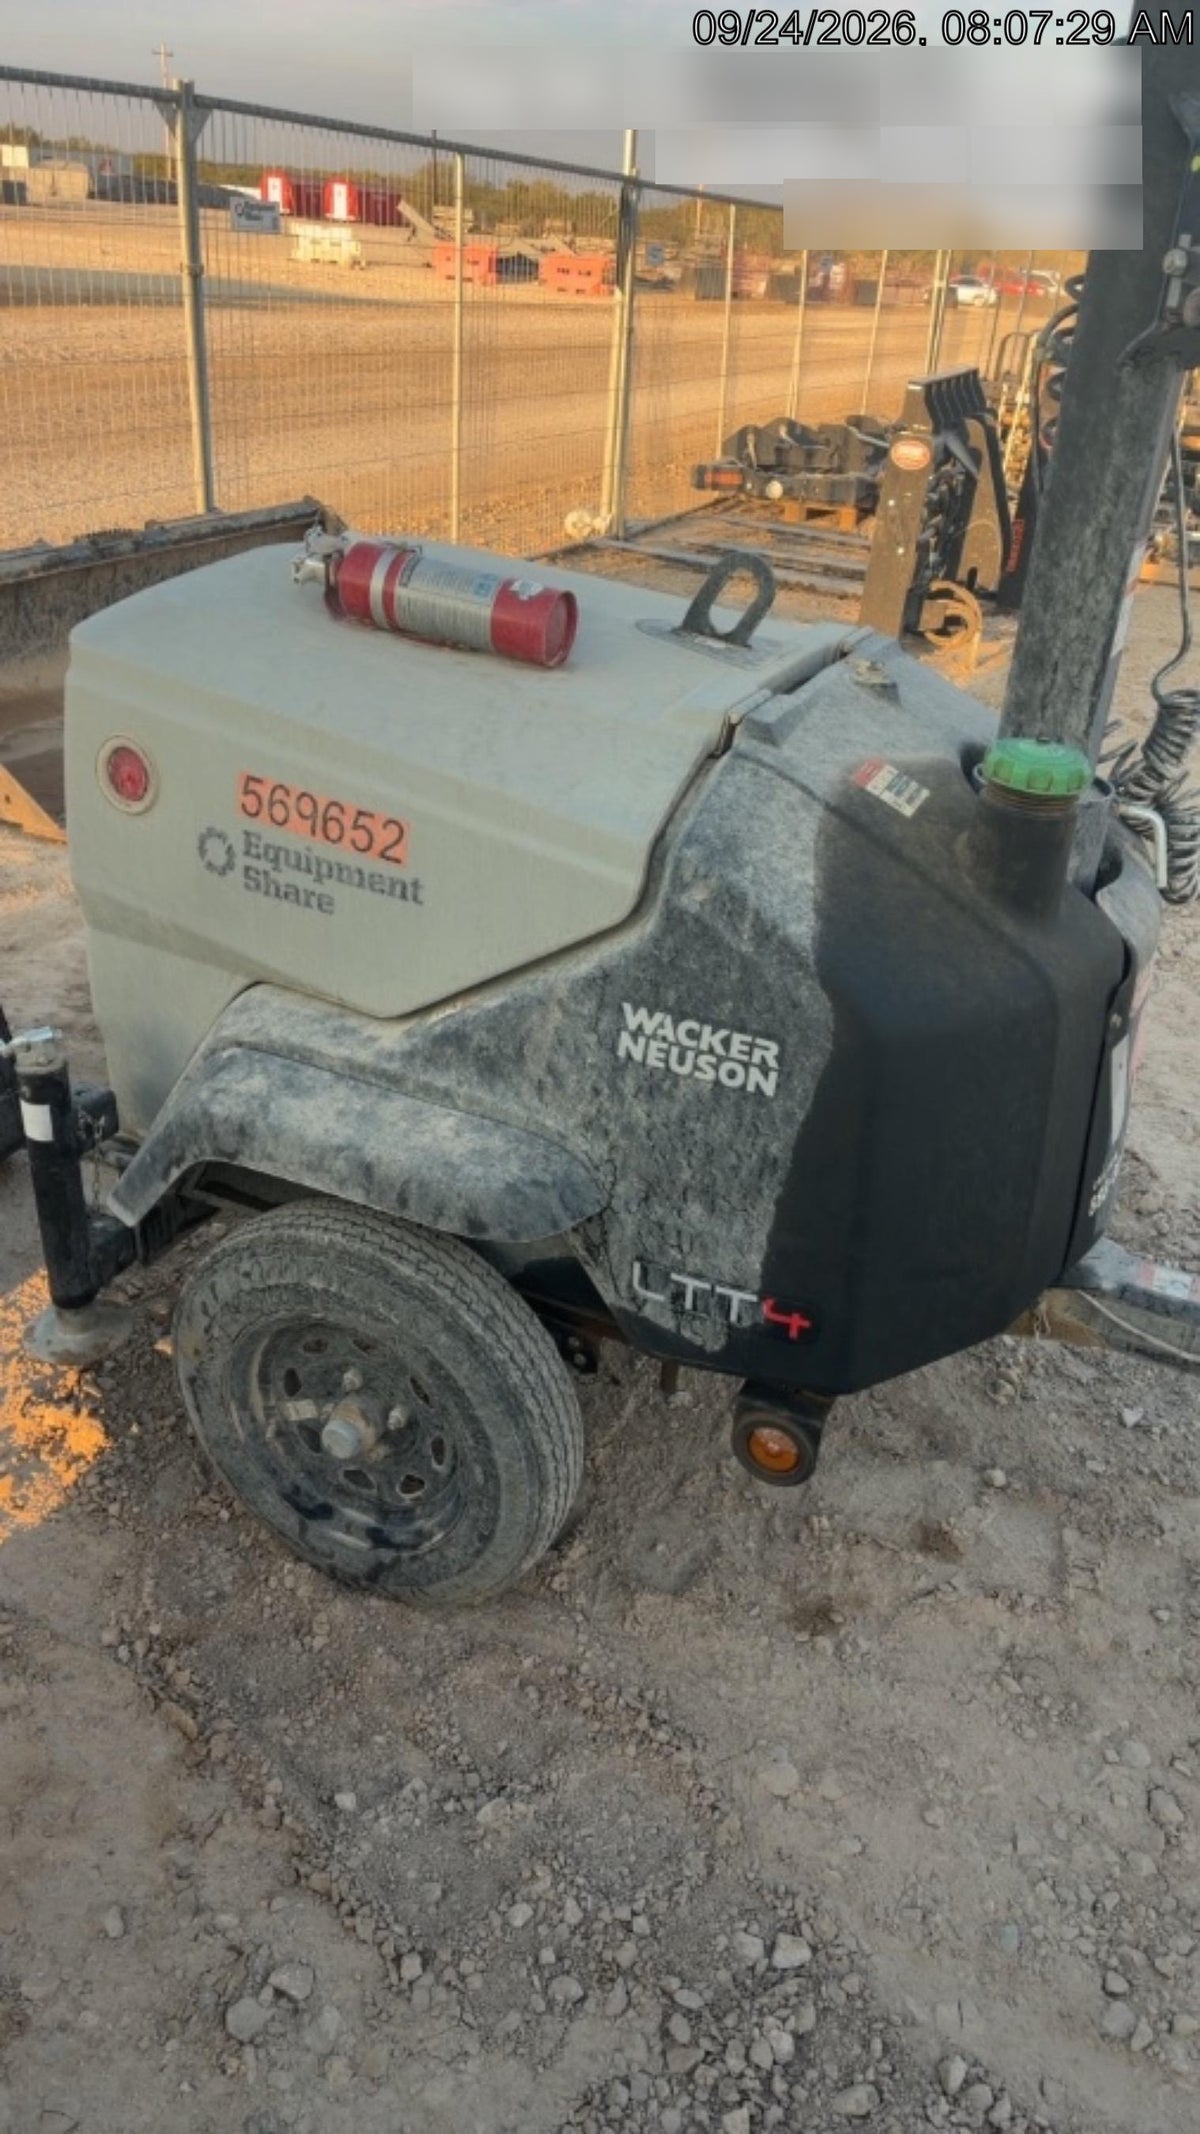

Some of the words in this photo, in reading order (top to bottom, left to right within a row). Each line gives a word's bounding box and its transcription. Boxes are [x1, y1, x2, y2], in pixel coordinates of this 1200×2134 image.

[240, 774, 407, 864] 569652
[242, 829, 425, 906] Equipment
[243, 865, 336, 916] Share
[617, 1031, 779, 1098] NEUSON
[621, 1002, 780, 1070] WACKER
[632, 1260, 812, 1341] LTT4
